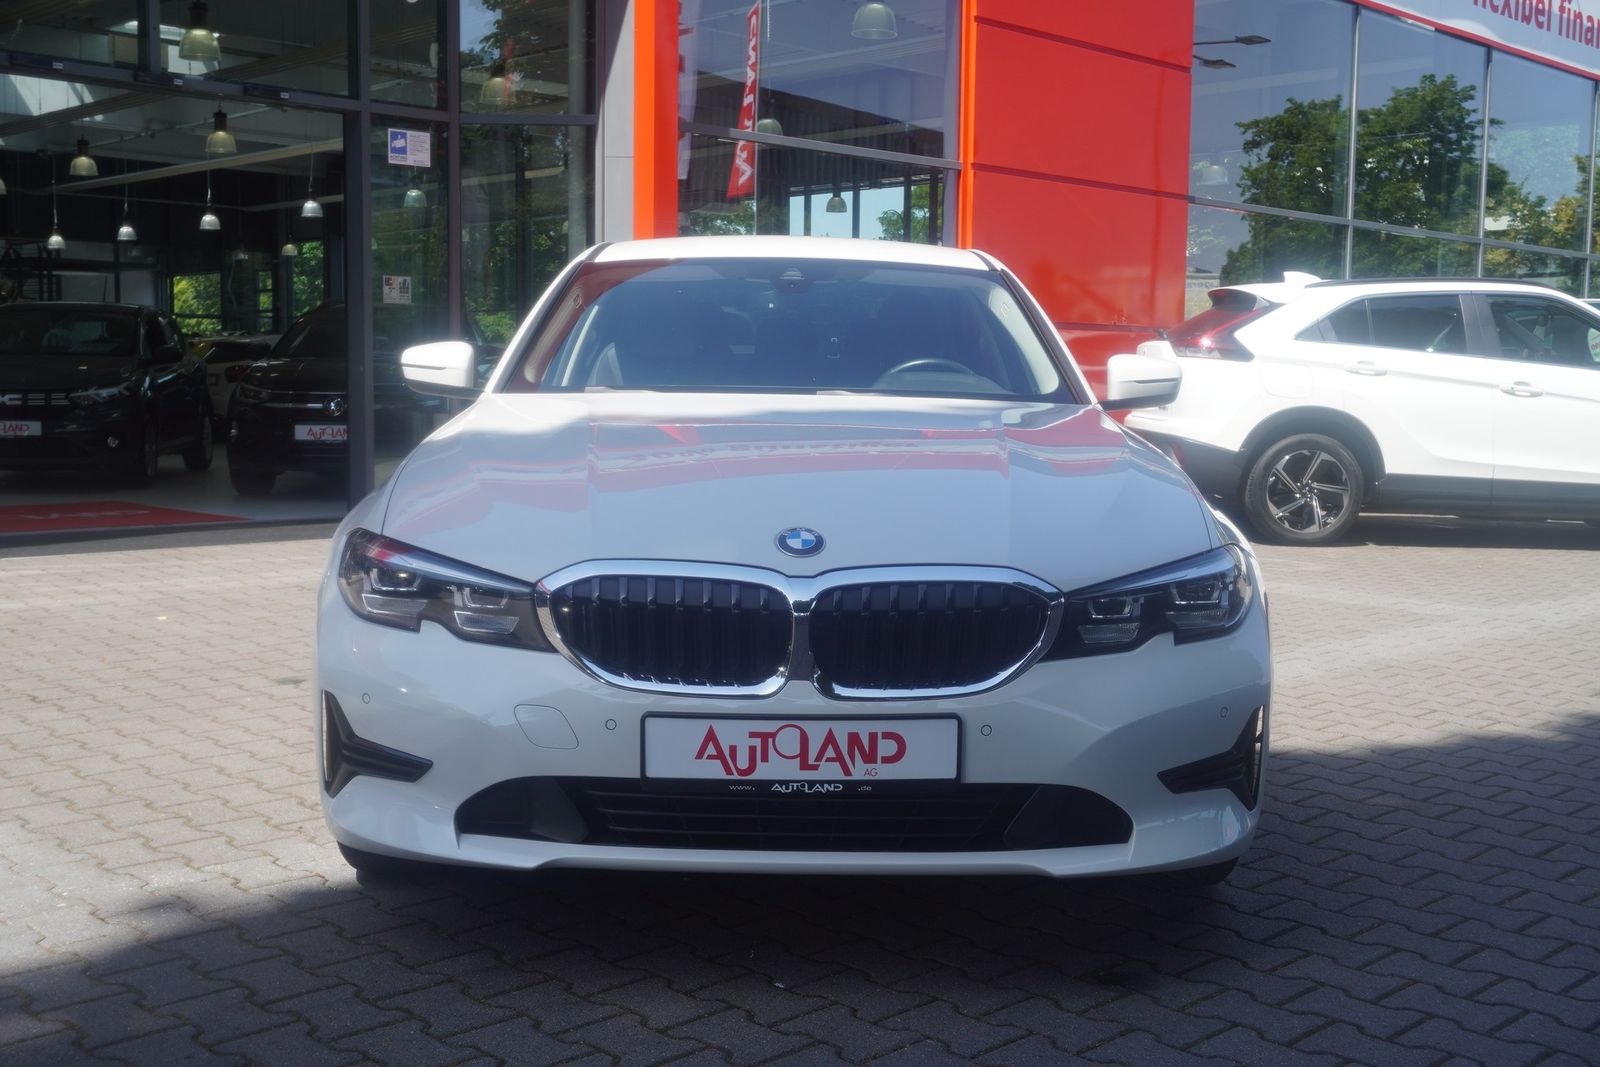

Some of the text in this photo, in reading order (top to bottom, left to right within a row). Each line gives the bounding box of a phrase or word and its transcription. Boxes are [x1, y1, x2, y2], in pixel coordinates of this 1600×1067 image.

[694, 723, 907, 777] AUTOLAND
[863, 768, 878, 777] AG
[770, 781, 844, 793] AUTOLAND
